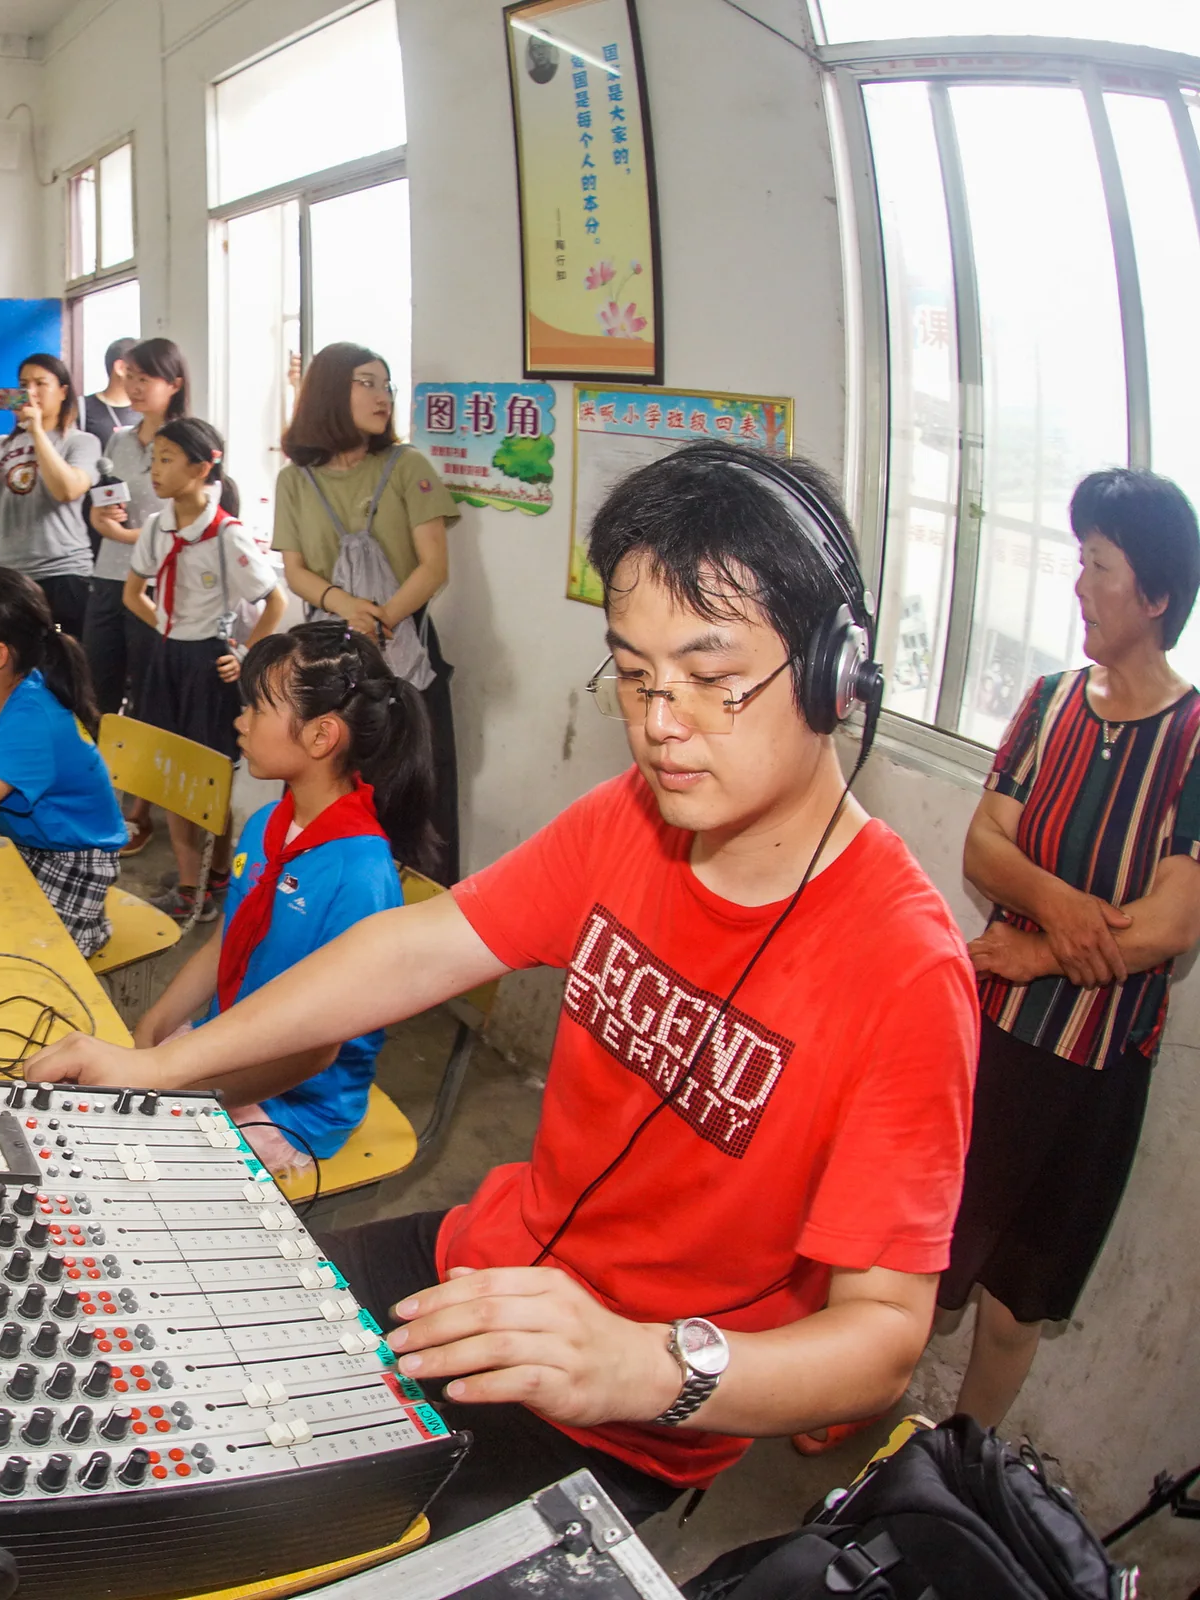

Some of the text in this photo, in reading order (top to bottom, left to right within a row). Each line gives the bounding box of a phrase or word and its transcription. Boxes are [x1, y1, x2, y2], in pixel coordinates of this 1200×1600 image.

[426, 393, 541, 438] 图书角
[563, 972, 751, 1143] ETERNITY
[569, 912, 782, 1113] LEGEND
[417, 1405, 441, 1432] MIC1
